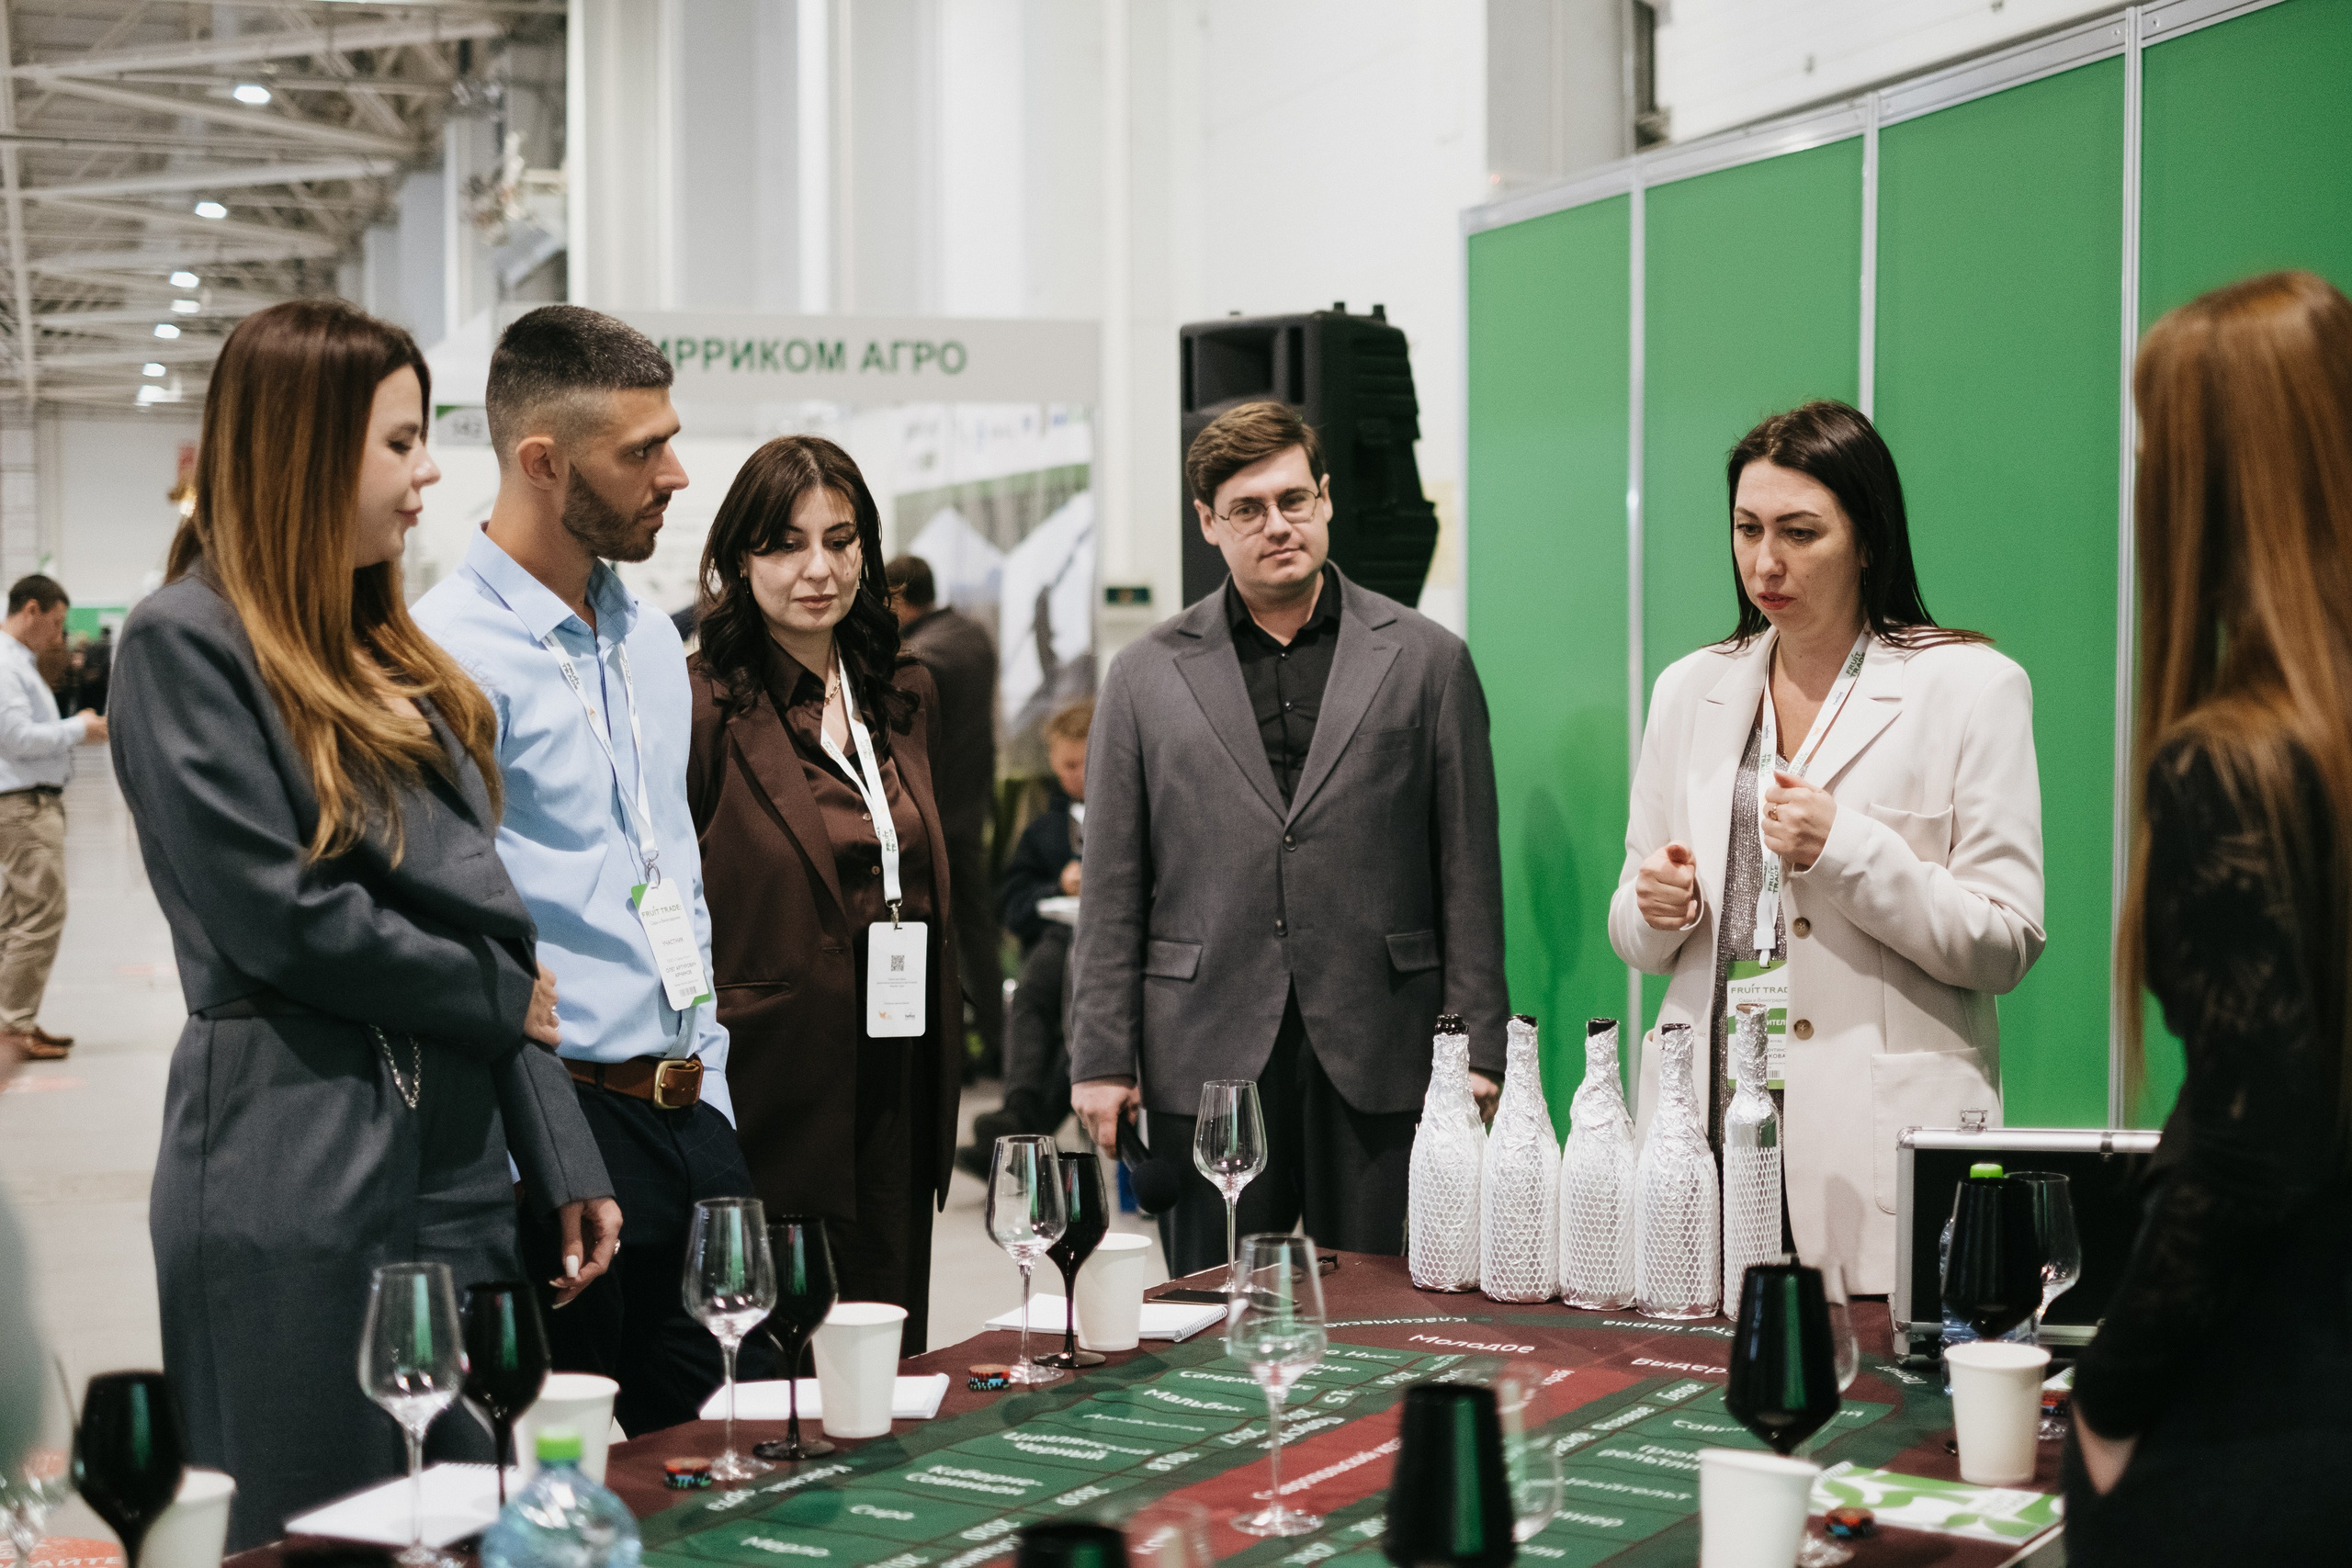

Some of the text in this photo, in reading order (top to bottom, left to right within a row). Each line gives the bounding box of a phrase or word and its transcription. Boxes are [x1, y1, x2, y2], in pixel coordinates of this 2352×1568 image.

[860, 338, 967, 374] АГРО
[1324, 1316, 1467, 1328] Классическо
[1603, 1320, 1683, 1332] Шарма
[1409, 1334, 1535, 1354] Молодое
[1631, 1358, 1728, 1375] Выдер
[1143, 1388, 1245, 1413] Мальбек
[1657, 1383, 1704, 1402] Белое
